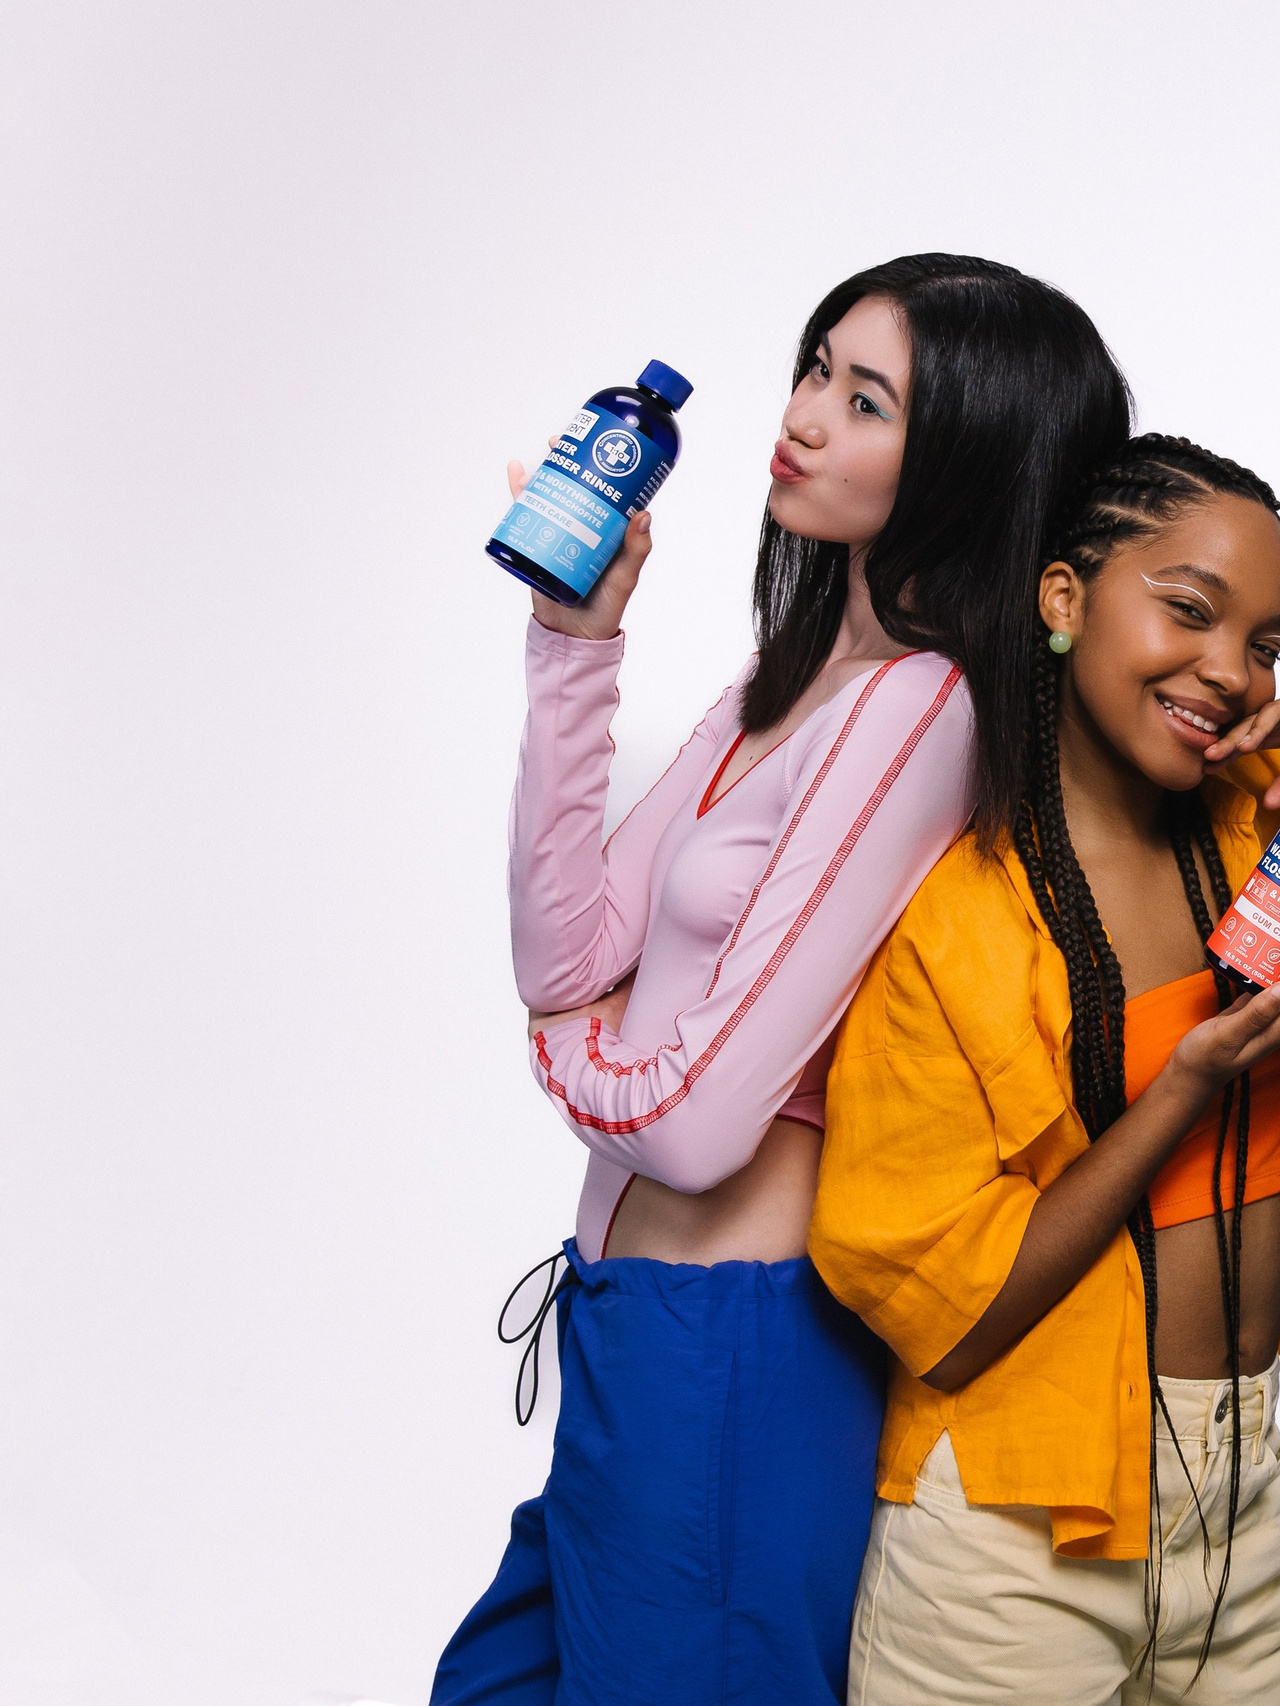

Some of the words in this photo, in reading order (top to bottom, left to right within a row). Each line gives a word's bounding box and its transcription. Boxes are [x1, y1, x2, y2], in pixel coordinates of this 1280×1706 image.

[610, 447, 625, 459] 1:10
[547, 452, 581, 475] OSSER
[580, 469, 622, 503] RINSE
[524, 495, 547, 511] TEETH
[548, 508, 573, 528] CARE
[533, 482, 551, 494] WITH
[551, 491, 603, 529] BISCHOFITE
[540, 472, 546, 480] &
[545, 474, 610, 520] MOUTHWASH
[1269, 889, 1277, 899] &
[1252, 912, 1273, 930] GUM
[1224, 950, 1236, 960] 16.9
[1235, 957, 1242, 966] FL
[1242, 963, 1252, 972] OZ
[1251, 969, 1265, 980] (500
[1265, 978, 1274, 986] mL
